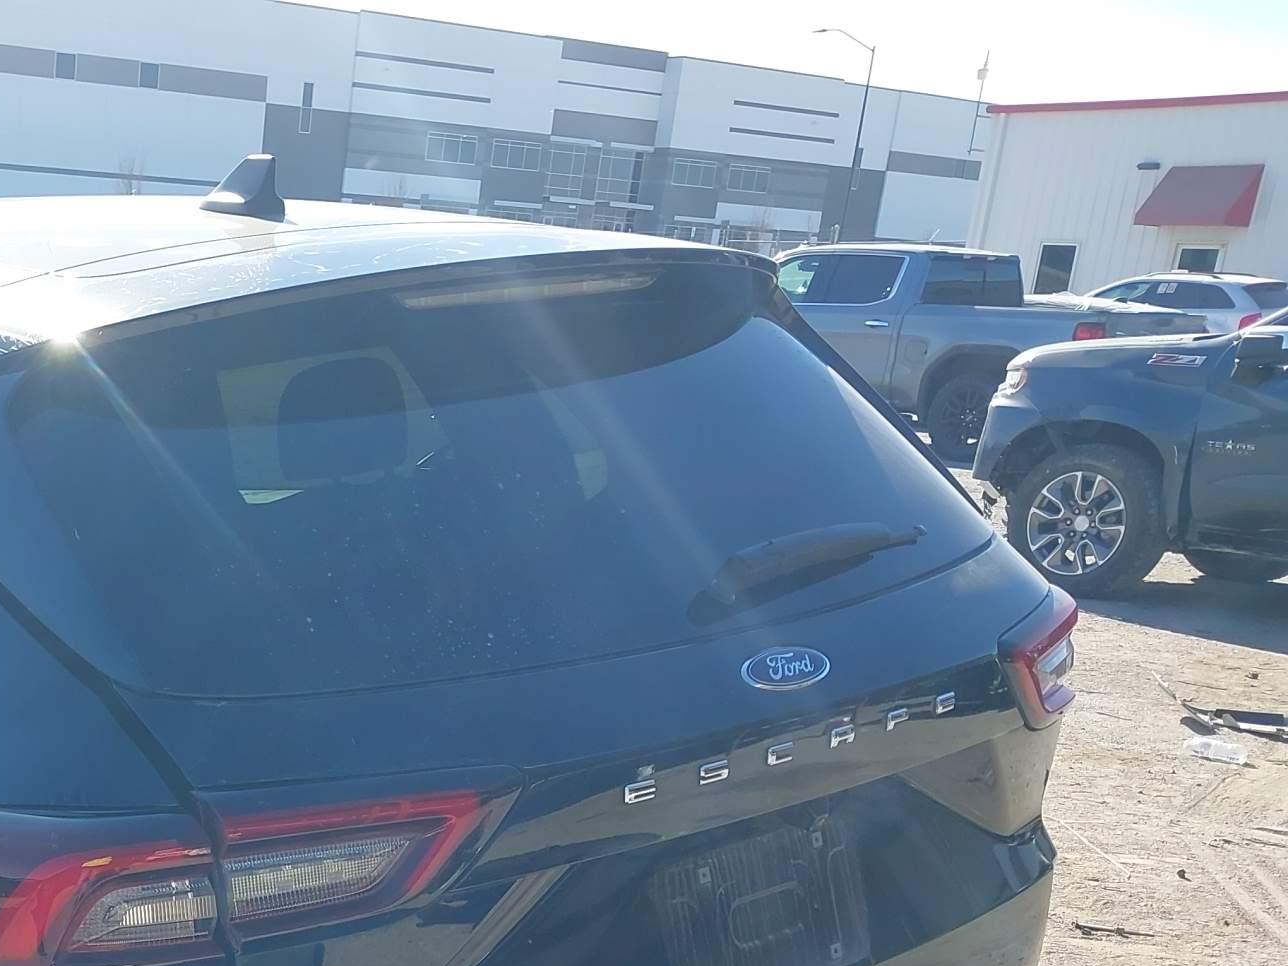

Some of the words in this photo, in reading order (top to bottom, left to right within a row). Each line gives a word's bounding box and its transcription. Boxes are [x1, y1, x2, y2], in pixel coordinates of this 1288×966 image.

[1146, 352, 1208, 368] Z71
[766, 652, 814, 680] Ford
[623, 691, 957, 805] ESCAPE
